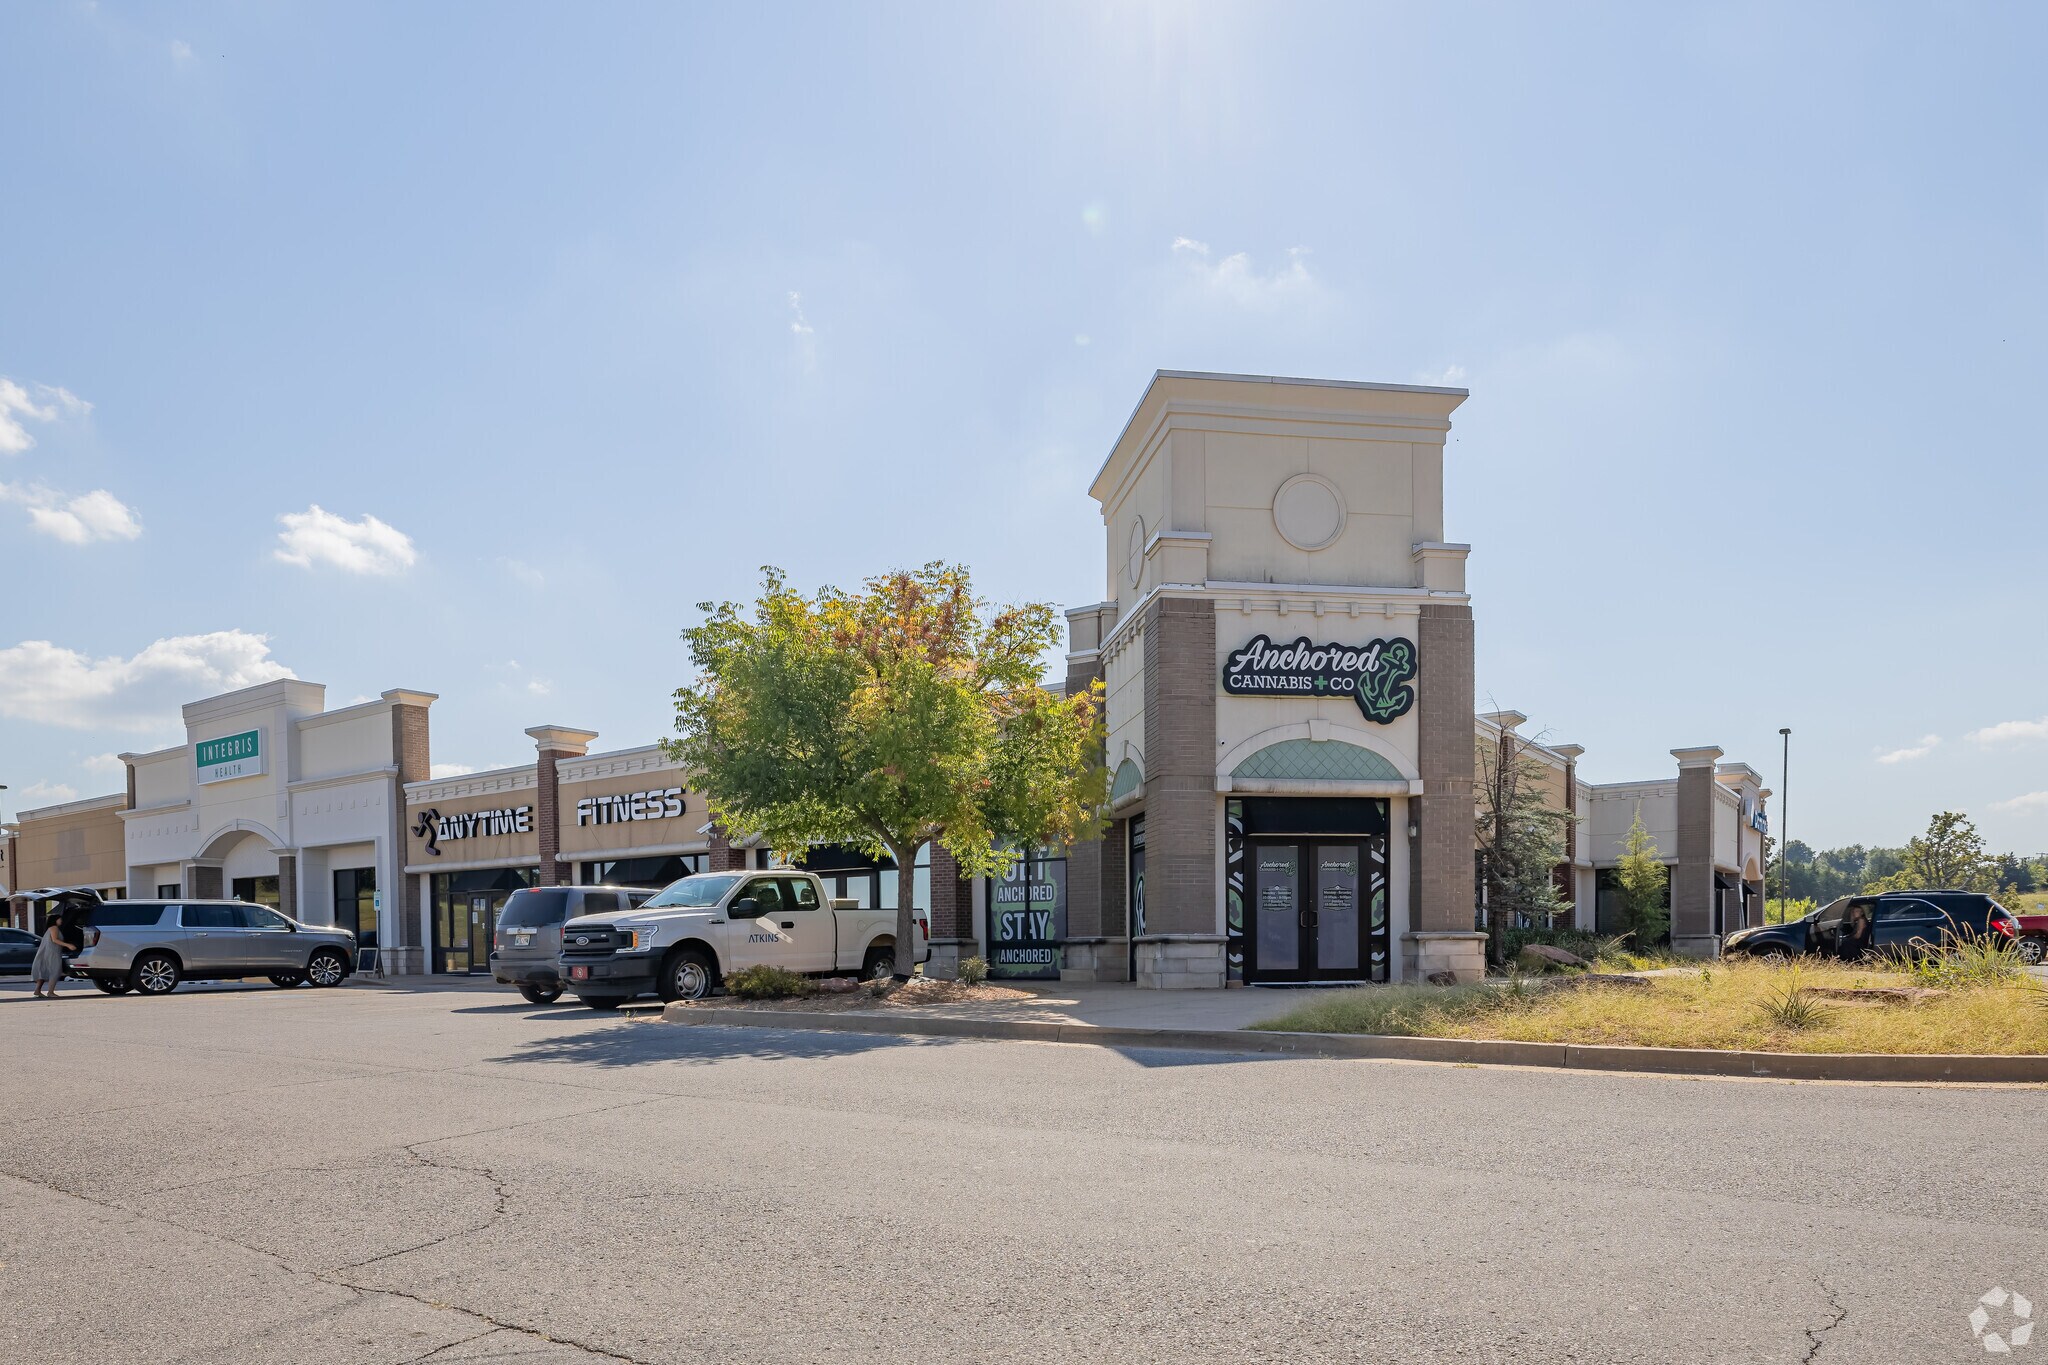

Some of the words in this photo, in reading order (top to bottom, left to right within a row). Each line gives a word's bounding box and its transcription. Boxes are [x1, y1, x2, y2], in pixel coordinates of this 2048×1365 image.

[1230, 640, 1380, 673] Anchored
[1229, 674, 1313, 689] CANNABIS
[1330, 677, 1355, 691] CO
[203, 737, 252, 762] INTEGRIS
[215, 764, 241, 778] HEALTH
[577, 787, 684, 827] FITNESS
[437, 806, 532, 841] ANYTIME
[748, 933, 779, 943] ATKINS
[1002, 912, 1048, 940] STAY
[1000, 949, 1051, 963] ANCHORED
